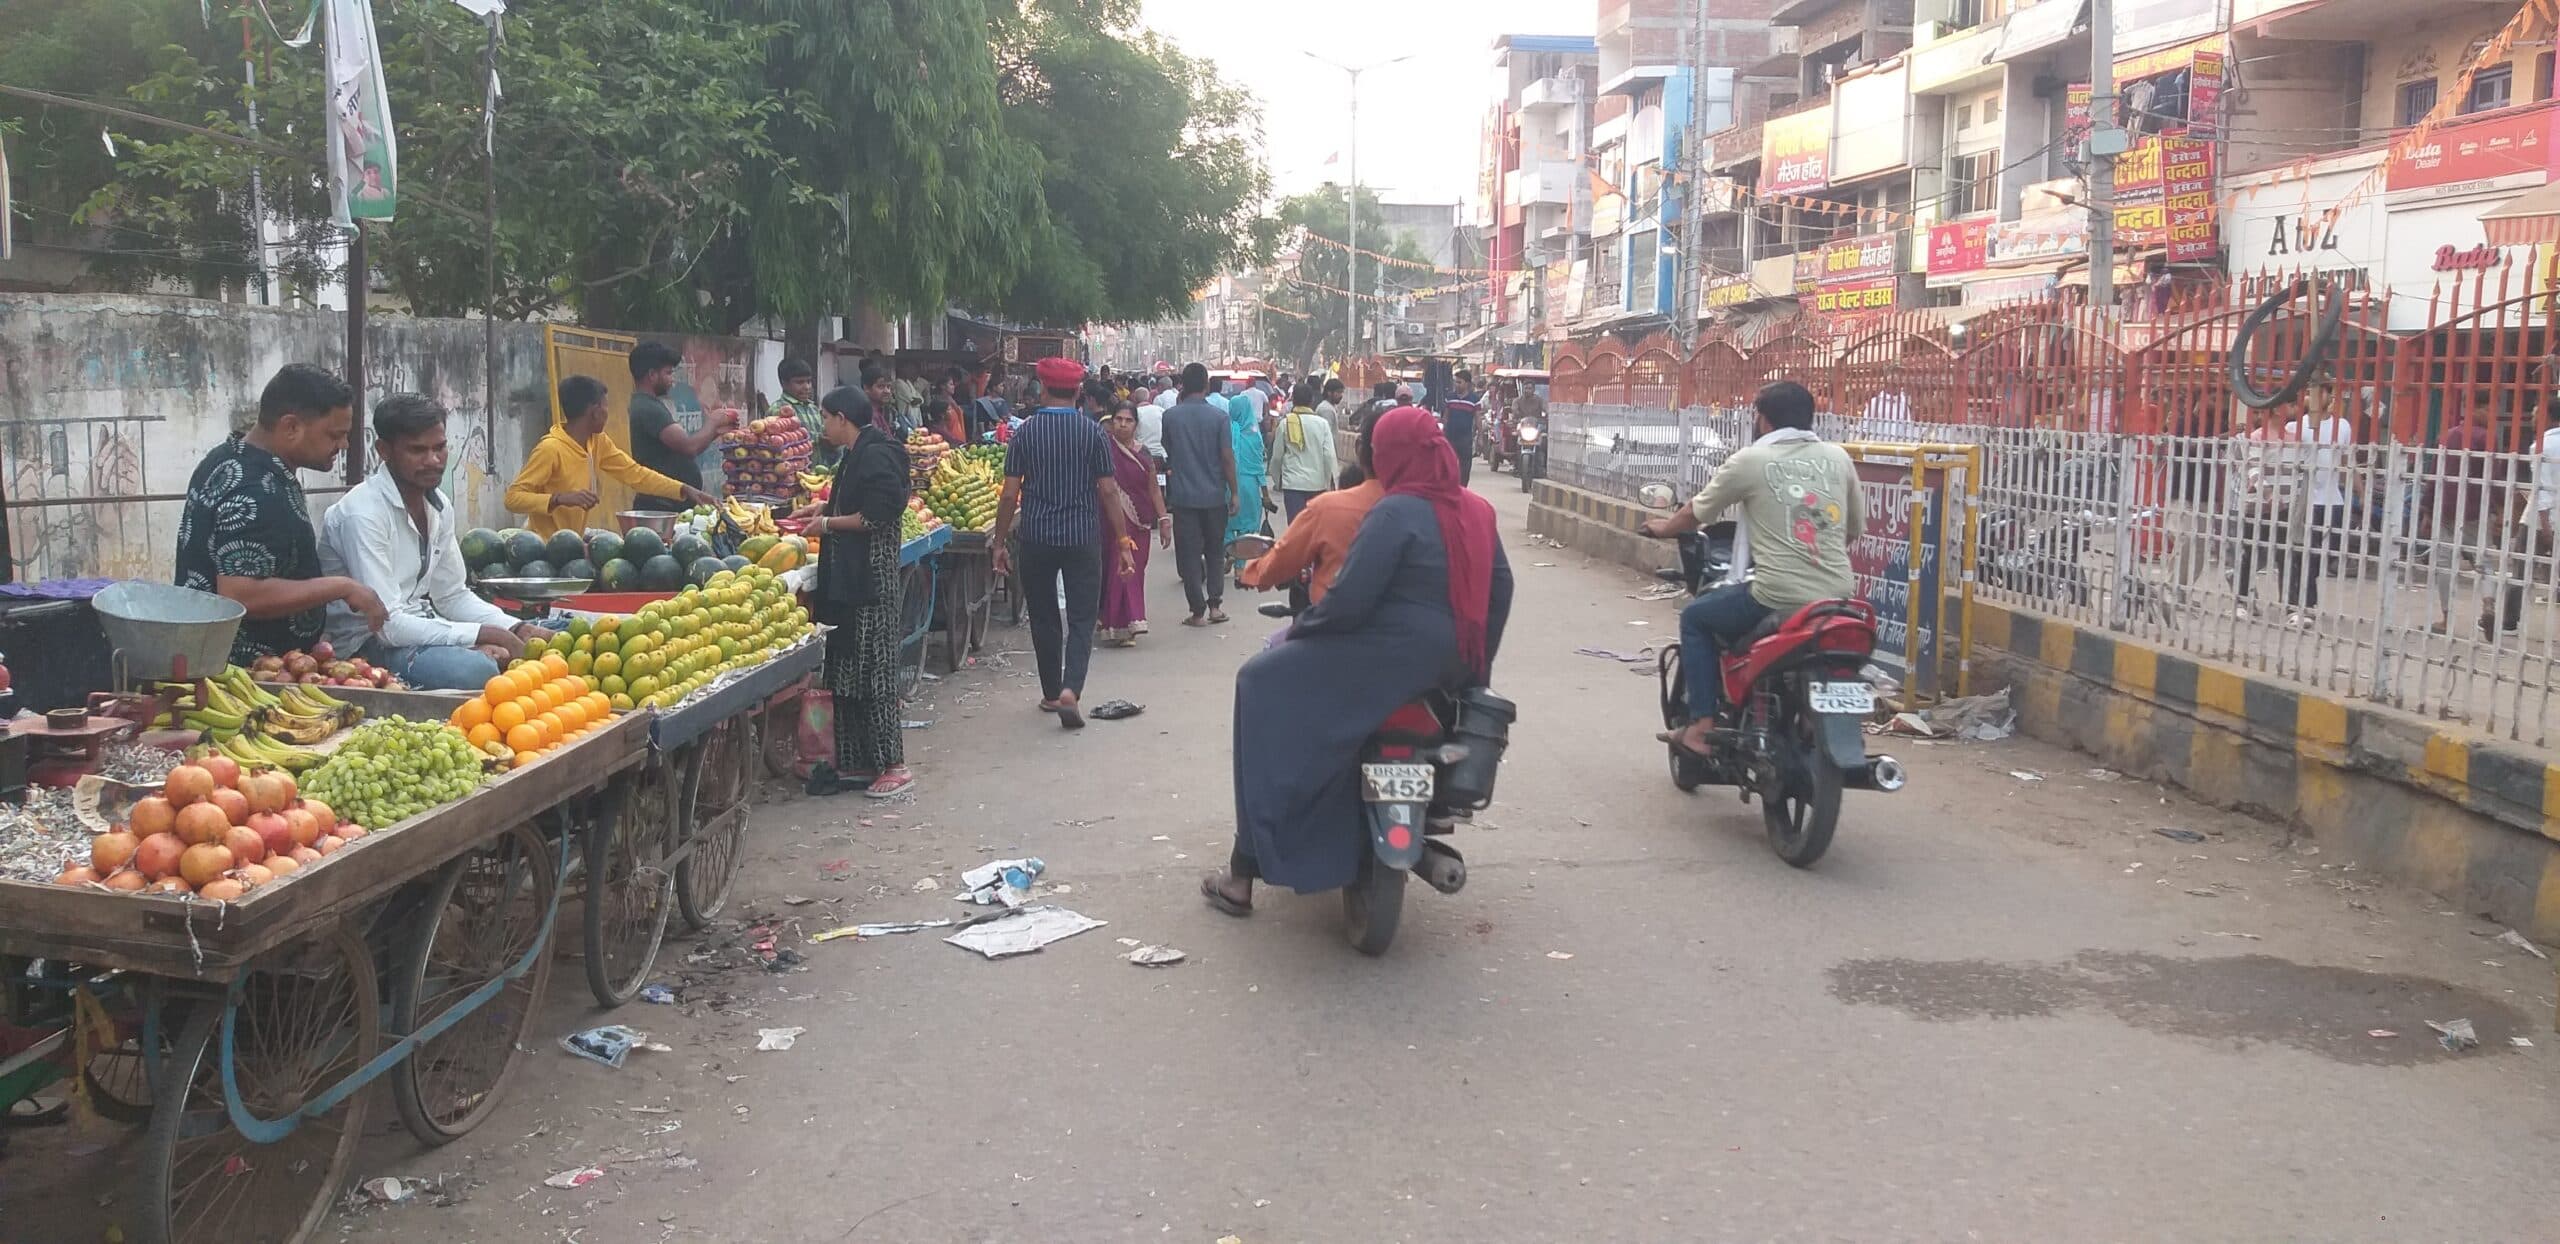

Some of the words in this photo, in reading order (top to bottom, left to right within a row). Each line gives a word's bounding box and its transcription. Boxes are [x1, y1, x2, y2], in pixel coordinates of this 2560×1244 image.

[2068, 91, 2092, 104] बाल
[1777, 160, 1800, 183] मैरेज
[1801, 156, 1823, 182] हॉल
[2114, 137, 2159, 186] ालाजी
[2165, 162, 2208, 180] वन्दना
[2415, 156, 2441, 170] Dealer
[2167, 191, 2209, 211] वन्दना
[2268, 215, 2288, 256] A
[2295, 217, 2315, 252] to
[1860, 242, 1876, 267] मैरेज
[1877, 240, 1892, 266] हॉल
[2431, 243, 2500, 273] Bata
[1863, 287, 1893, 306] हाउस
[1885, 474, 1934, 534] पुलिस
[1815, 697, 1869, 710] 7082
[1373, 766, 1422, 777] BR24X
